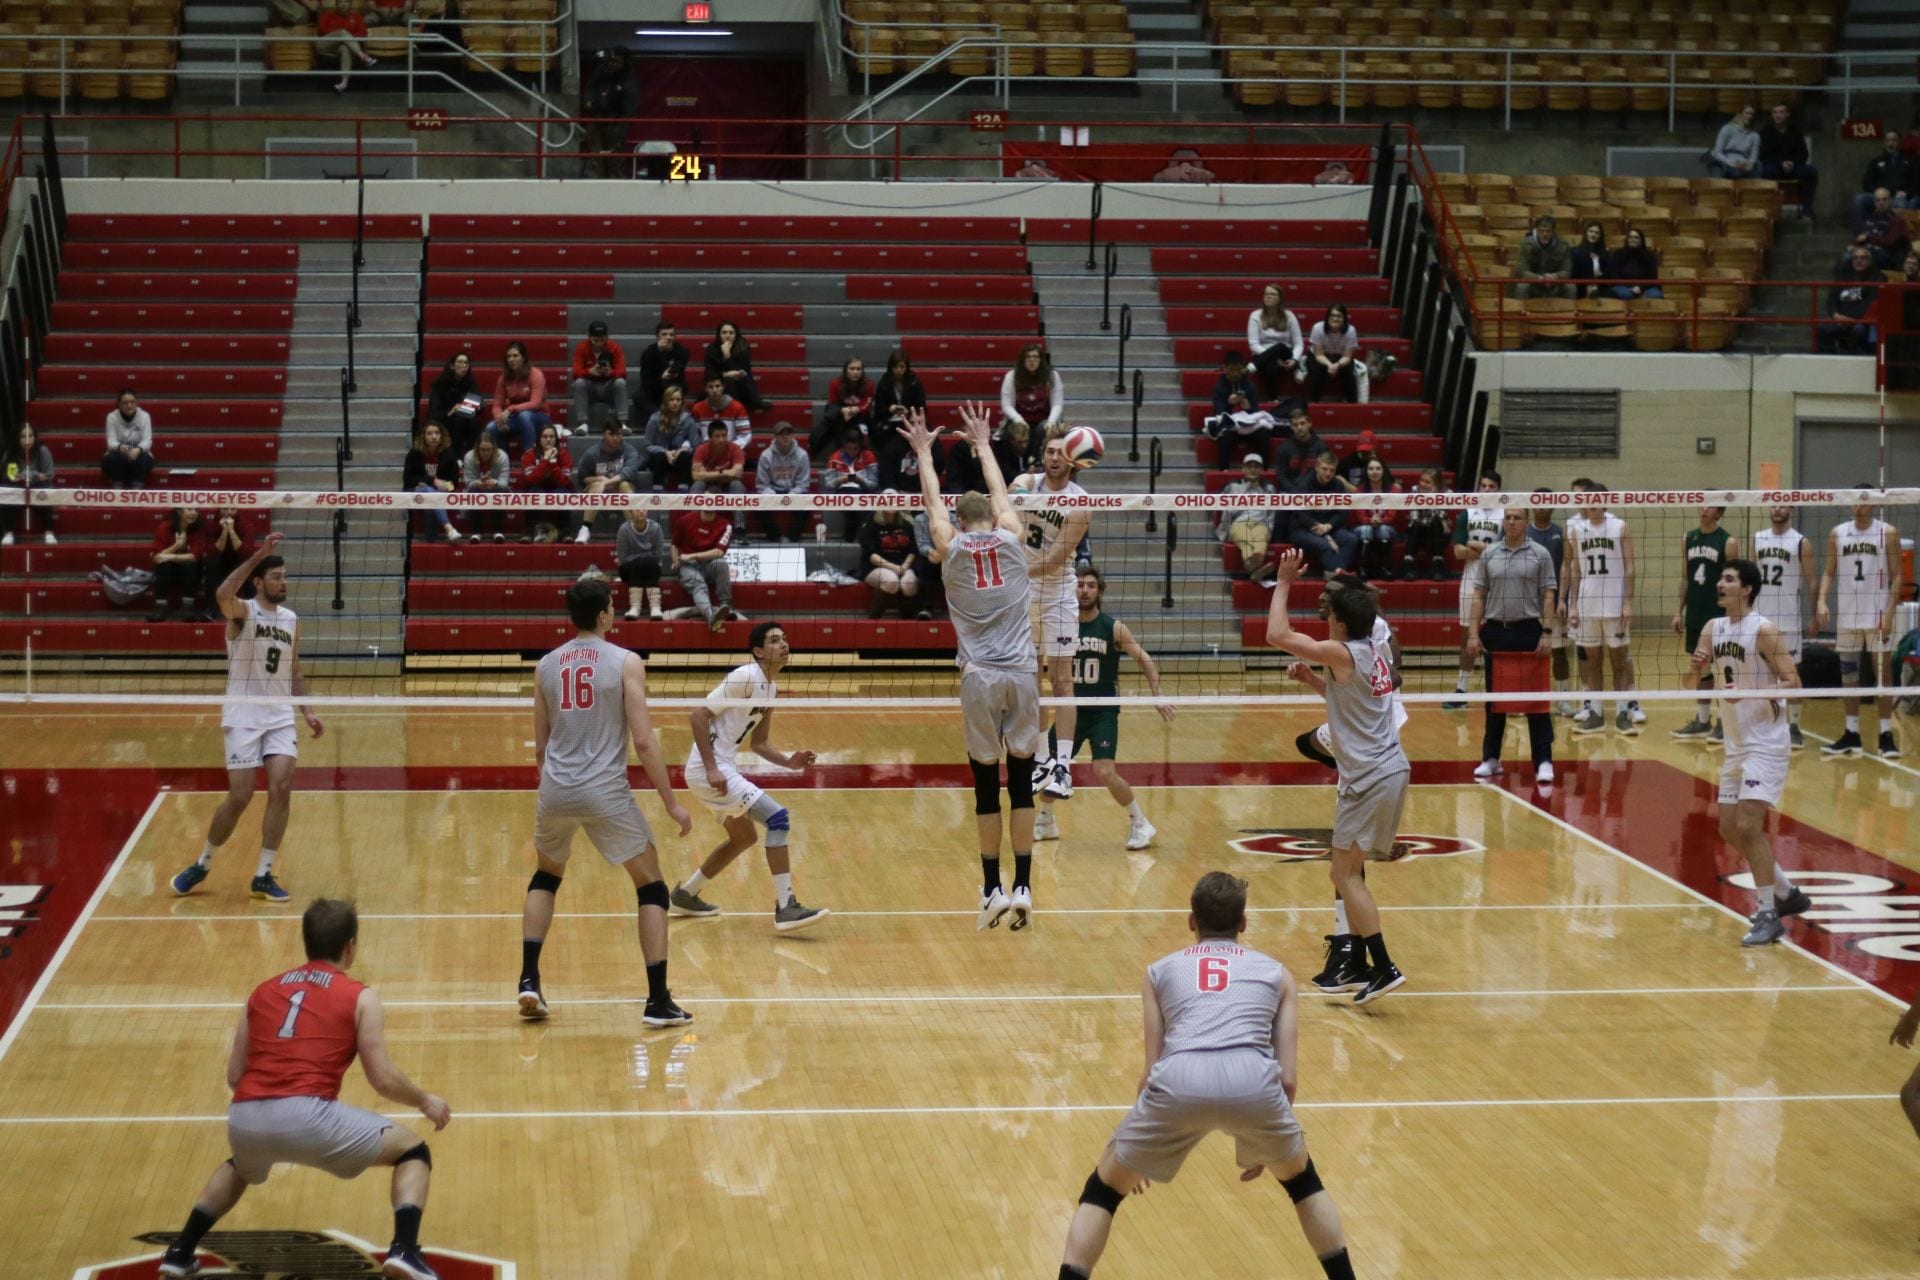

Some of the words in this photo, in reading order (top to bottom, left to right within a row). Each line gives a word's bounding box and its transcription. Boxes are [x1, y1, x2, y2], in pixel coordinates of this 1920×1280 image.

[974, 113, 1003, 128] 13A
[1852, 123, 1876, 137] 13A
[670, 155, 701, 180] 24
[73, 490, 116, 503] OHIO
[120, 491, 168, 504] STATE
[171, 492, 257, 504] BUCKEYES
[316, 493, 393, 505] #GoBucks
[447, 494, 488, 506] OHIO
[492, 494, 540, 506] STATE
[545, 494, 630, 506] BUCKEYES
[683, 495, 760, 507] #GoBucks
[813, 495, 854, 507] OHIO
[858, 495, 905, 507] STATE
[1047, 495, 1122, 507] #GoBucks
[1174, 495, 1215, 507] OHIO
[1219, 495, 1265, 507] STATE
[1270, 494, 1353, 506] BUCKEYES
[1404, 494, 1479, 506] #GoBucks
[1530, 493, 1570, 505] OHIO
[1574, 493, 1619, 505] STATE
[1624, 492, 1705, 504] BUCKEYES
[1761, 491, 1834, 503] #GoBucks
[1026, 523, 1043, 549] 3
[1581, 537, 1614, 550] MASON
[1687, 545, 1719, 562] MASON
[1758, 547, 1791, 563] MASON
[1842, 542, 1877, 556] MASON
[972, 547, 1004, 590] 11
[1587, 554, 1609, 575] 11
[1854, 560, 1865, 581] 1
[1694, 563, 1706, 585] 4
[1762, 564, 1783, 586] 12
[255, 624, 292, 647] MASON
[1714, 641, 1745, 663] MASON
[265, 647, 281, 674] 9
[1072, 657, 1100, 684] 10
[560, 666, 594, 711] 16
[1197, 957, 1230, 993] 6
[277, 990, 307, 1039] 1
